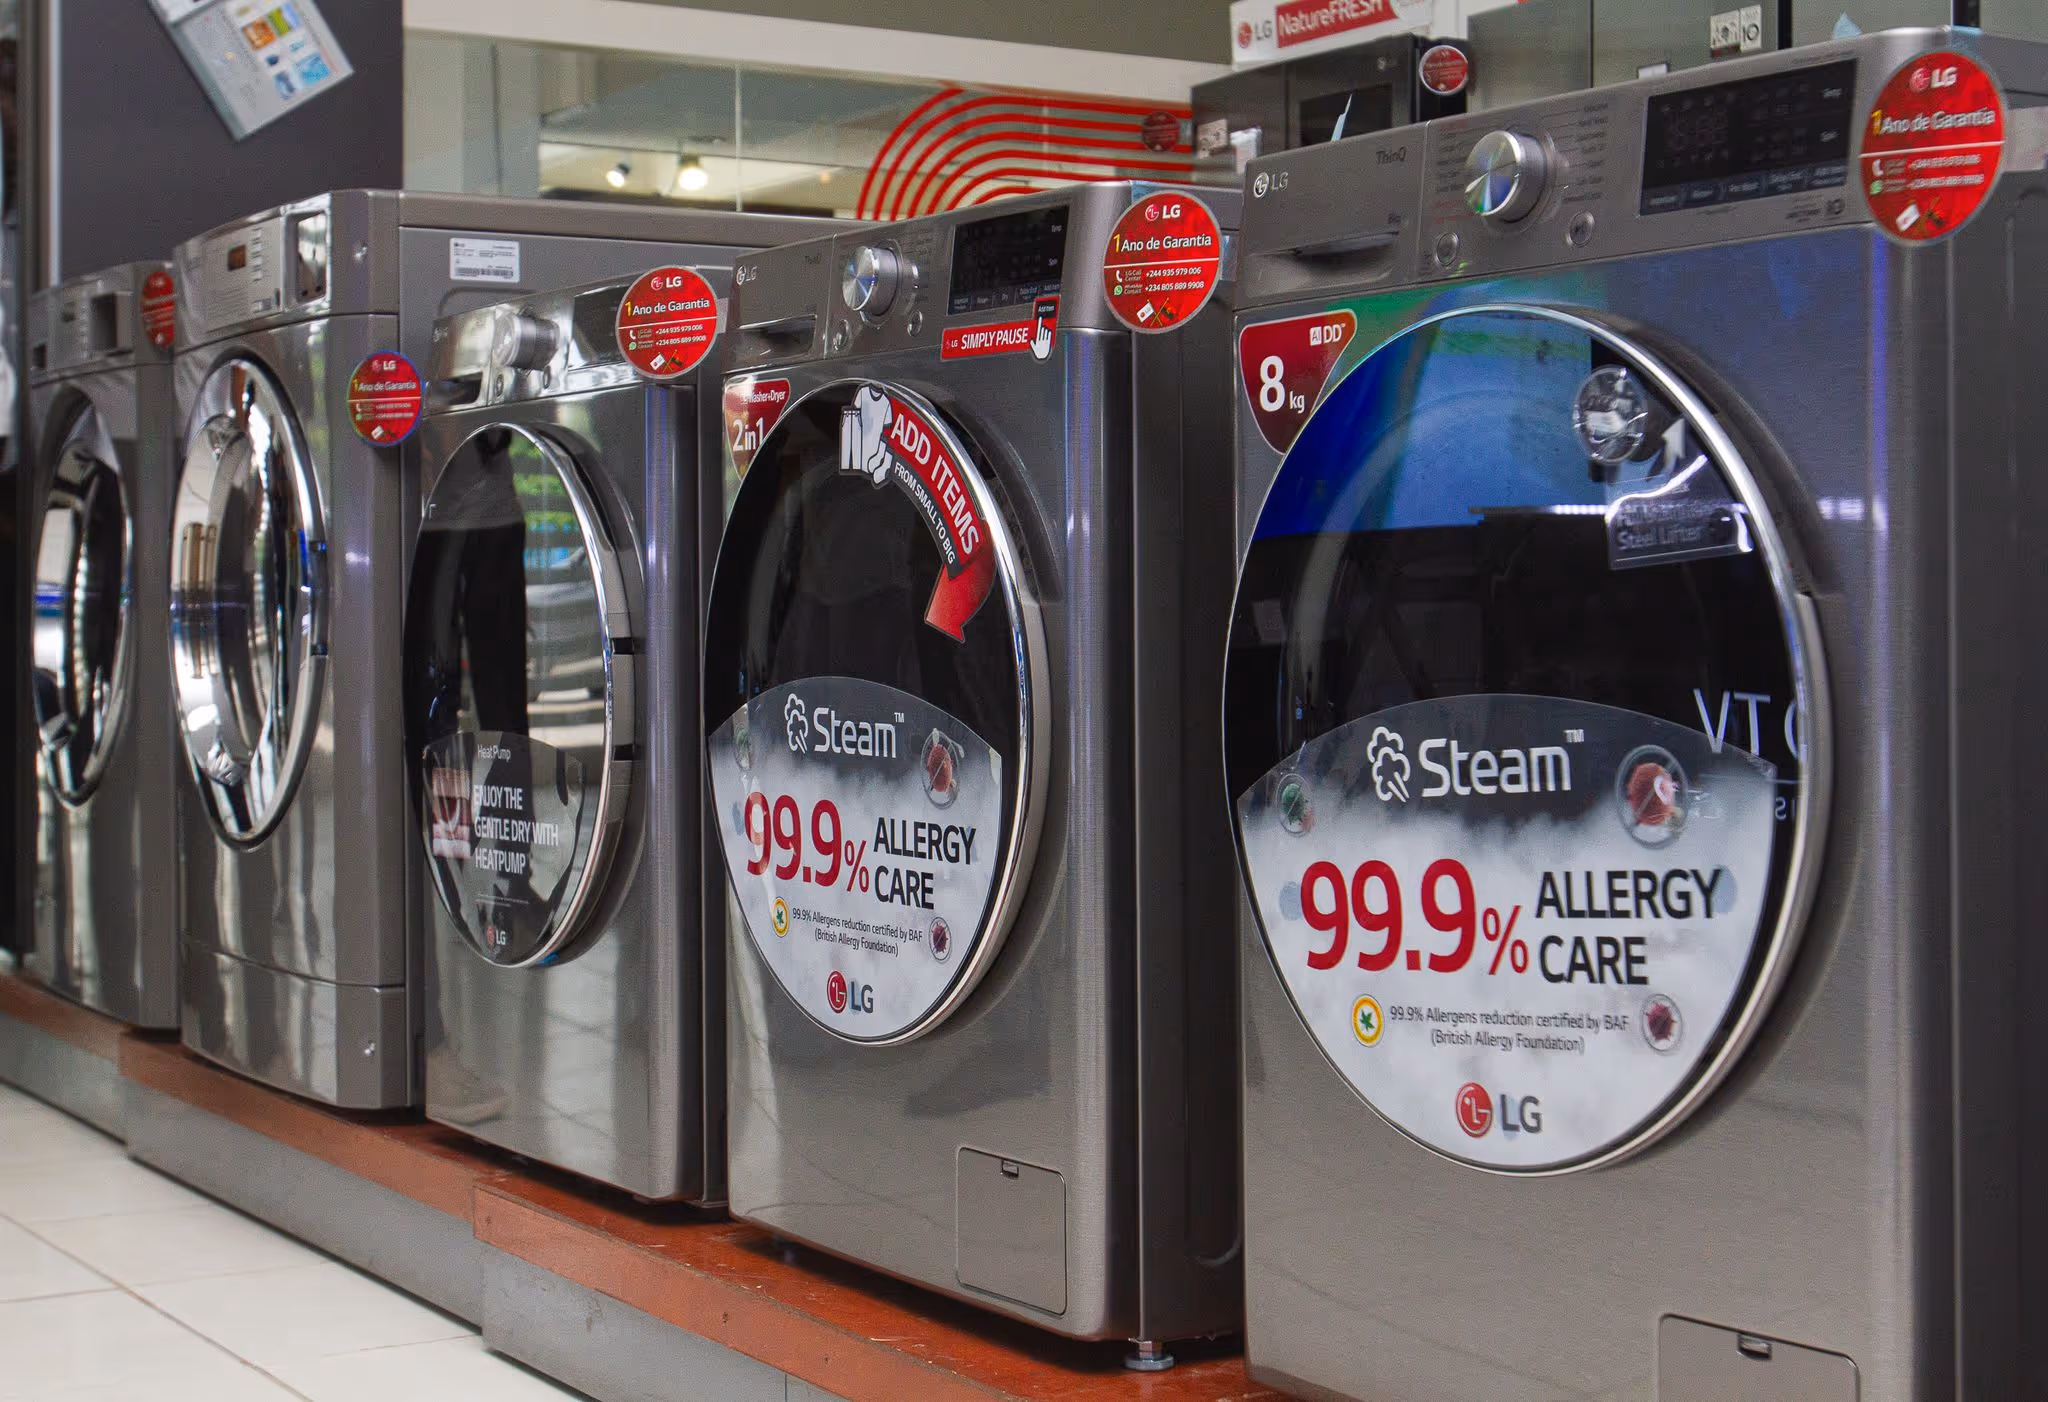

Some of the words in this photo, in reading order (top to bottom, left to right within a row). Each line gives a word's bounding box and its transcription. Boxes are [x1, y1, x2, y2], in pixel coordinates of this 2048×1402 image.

[1254, 21, 1273, 40] LG
[1930, 67, 1958, 88] LG
[1871, 109, 1882, 135] 1
[1881, 116, 1911, 134] Ano
[1911, 113, 1930, 131] de
[1272, 171, 1289, 191] LG
[1162, 204, 1181, 219] LG
[1113, 233, 1120, 253] 1
[1121, 239, 1144, 252] Ano
[1146, 237, 1160, 250] de
[665, 276, 682, 288] LG
[1146, 269, 1161, 278] +244
[1162, 268, 1175, 277] 935
[1176, 268, 1188, 276] 979
[1145, 284, 1160, 292] +234
[625, 302, 632, 316] 1
[632, 304, 652, 316] Ano
[654, 302, 666, 313] de
[951, 339, 958, 348] LG
[961, 331, 996, 350] SIMPLY
[996, 327, 1029, 345] PAUSE
[383, 361, 396, 371] LG
[358, 383, 373, 392] Ano
[374, 382, 384, 391] de
[1260, 355, 1286, 412] 8
[1289, 390, 1305, 413] kg
[891, 413, 931, 466] ADD
[931, 455, 979, 555] ITEMS
[894, 462, 916, 492] FROM
[914, 484, 936, 525] SMALL
[935, 518, 947, 540] TO
[942, 534, 956, 565] BIG
[473, 784, 503, 809] ENJOY
[504, 787, 523, 810] THE
[475, 818, 510, 842] GENTLE
[511, 820, 531, 844] DRY
[532, 823, 559, 846] WITH
[744, 791, 869, 893] 99.9%
[873, 817, 977, 865] ALLERGY
[475, 849, 526, 875] HEATPUMP
[874, 865, 935, 910] CARE
[1536, 868, 1724, 919] ALLERGY
[792, 907, 813, 922] 99.9%
[812, 911, 841, 929] Allergens
[841, 918, 871, 934] reduction
[871, 924, 899, 939] certified
[899, 928, 908, 944] by
[908, 930, 923, 943] BAF
[1300, 858, 1529, 976] 99.9%
[495, 930, 506, 946] LG
[814, 929, 837, 943] (British
[838, 935, 860, 950] Allergy
[860, 938, 899, 957] Foundation)
[1539, 933, 1650, 986] CARE
[850, 981, 874, 1014] LG
[1389, 1005, 1424, 1022] 99.9%
[1426, 1006, 1478, 1026] Allergens
[1480, 1010, 1533, 1027] reduction
[1536, 1011, 1584, 1029] certified
[1586, 1013, 1602, 1034] by
[1603, 1015, 1630, 1032] BAF
[1430, 1028, 1472, 1047] (British
[1475, 1030, 1513, 1052] Allergy
[1515, 1033, 1586, 1055] Foundation)
[1500, 1093, 1543, 1134] LG
